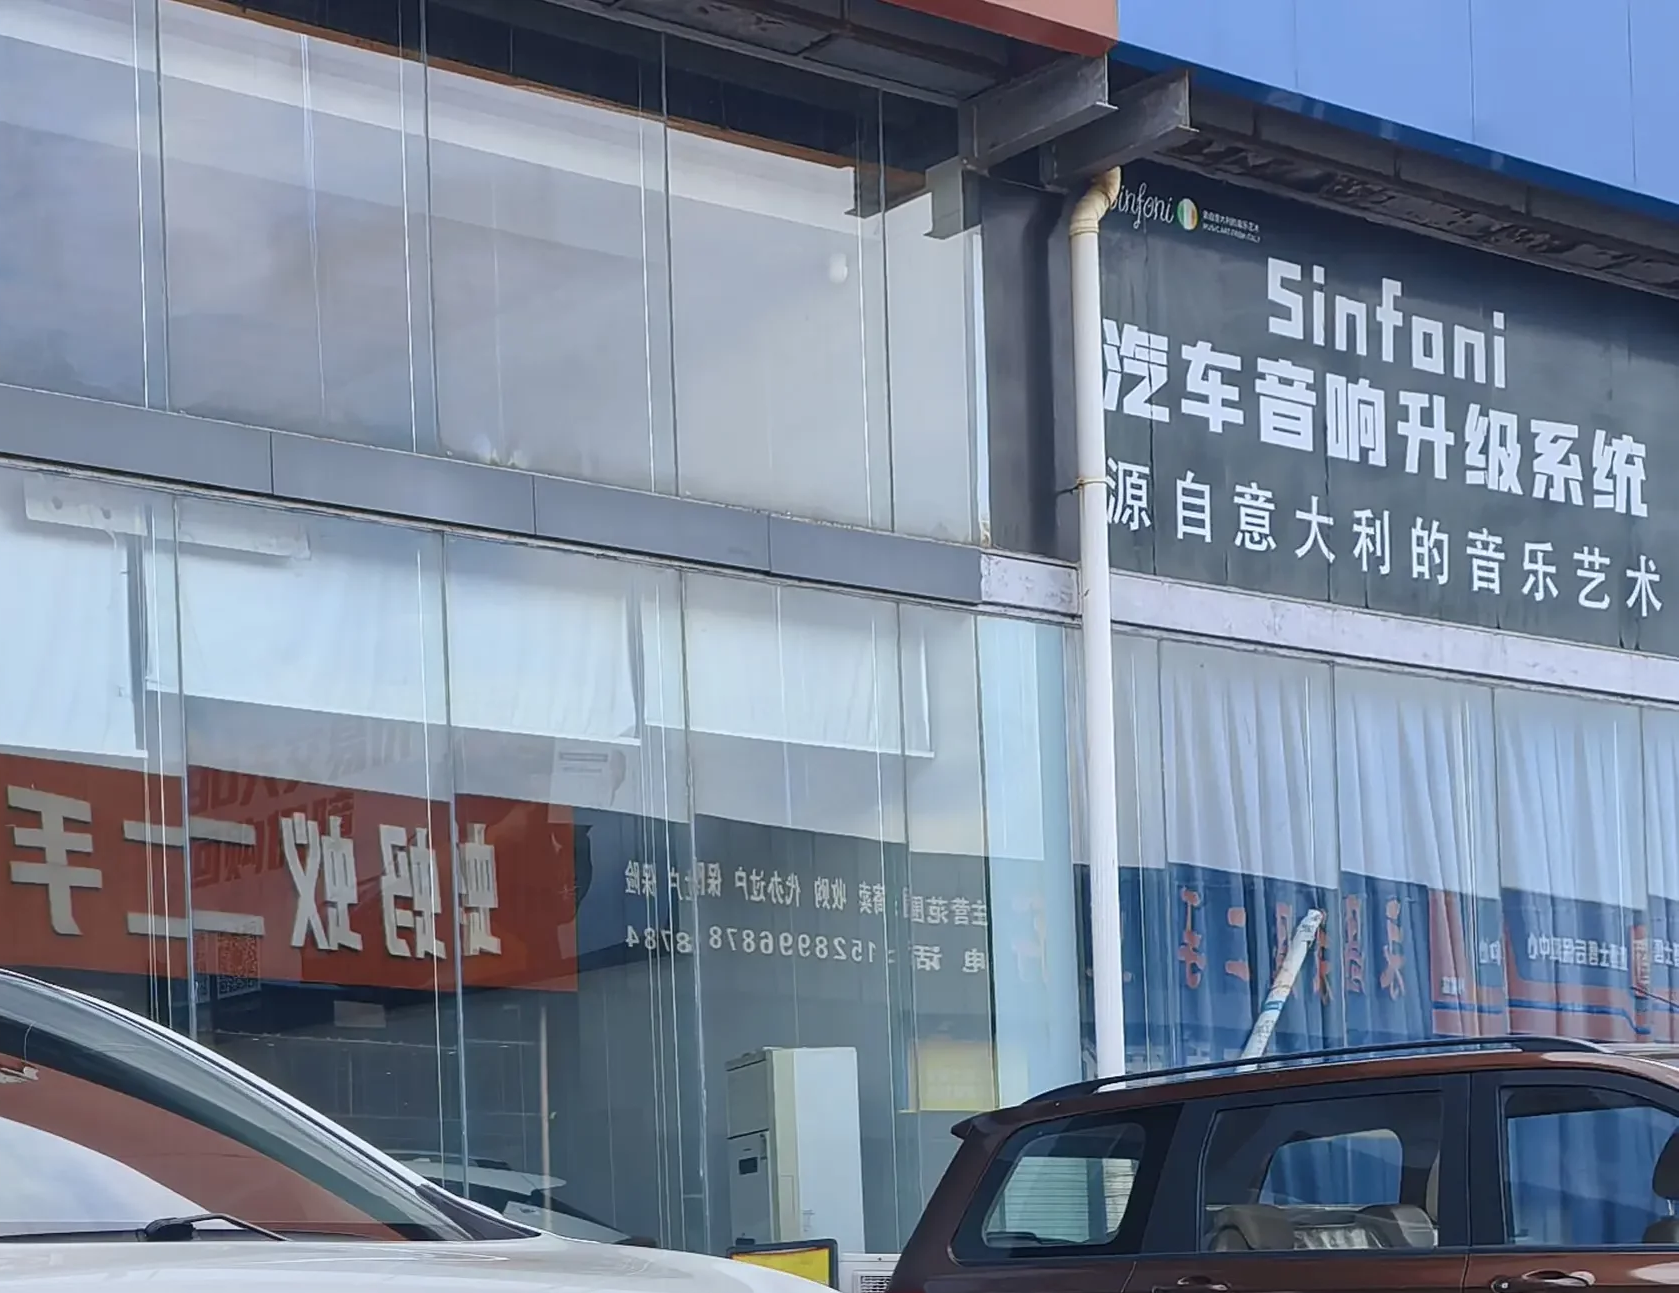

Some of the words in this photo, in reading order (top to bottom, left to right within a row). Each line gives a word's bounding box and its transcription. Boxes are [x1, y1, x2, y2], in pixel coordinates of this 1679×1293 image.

[1110, 182, 1174, 229] infoni
[1267, 257, 1506, 389] Sinfoni
[1103, 317, 1649, 518] 汽车音响升级系统
[1106, 457, 1663, 618] 源自意大利的音乐艺术
